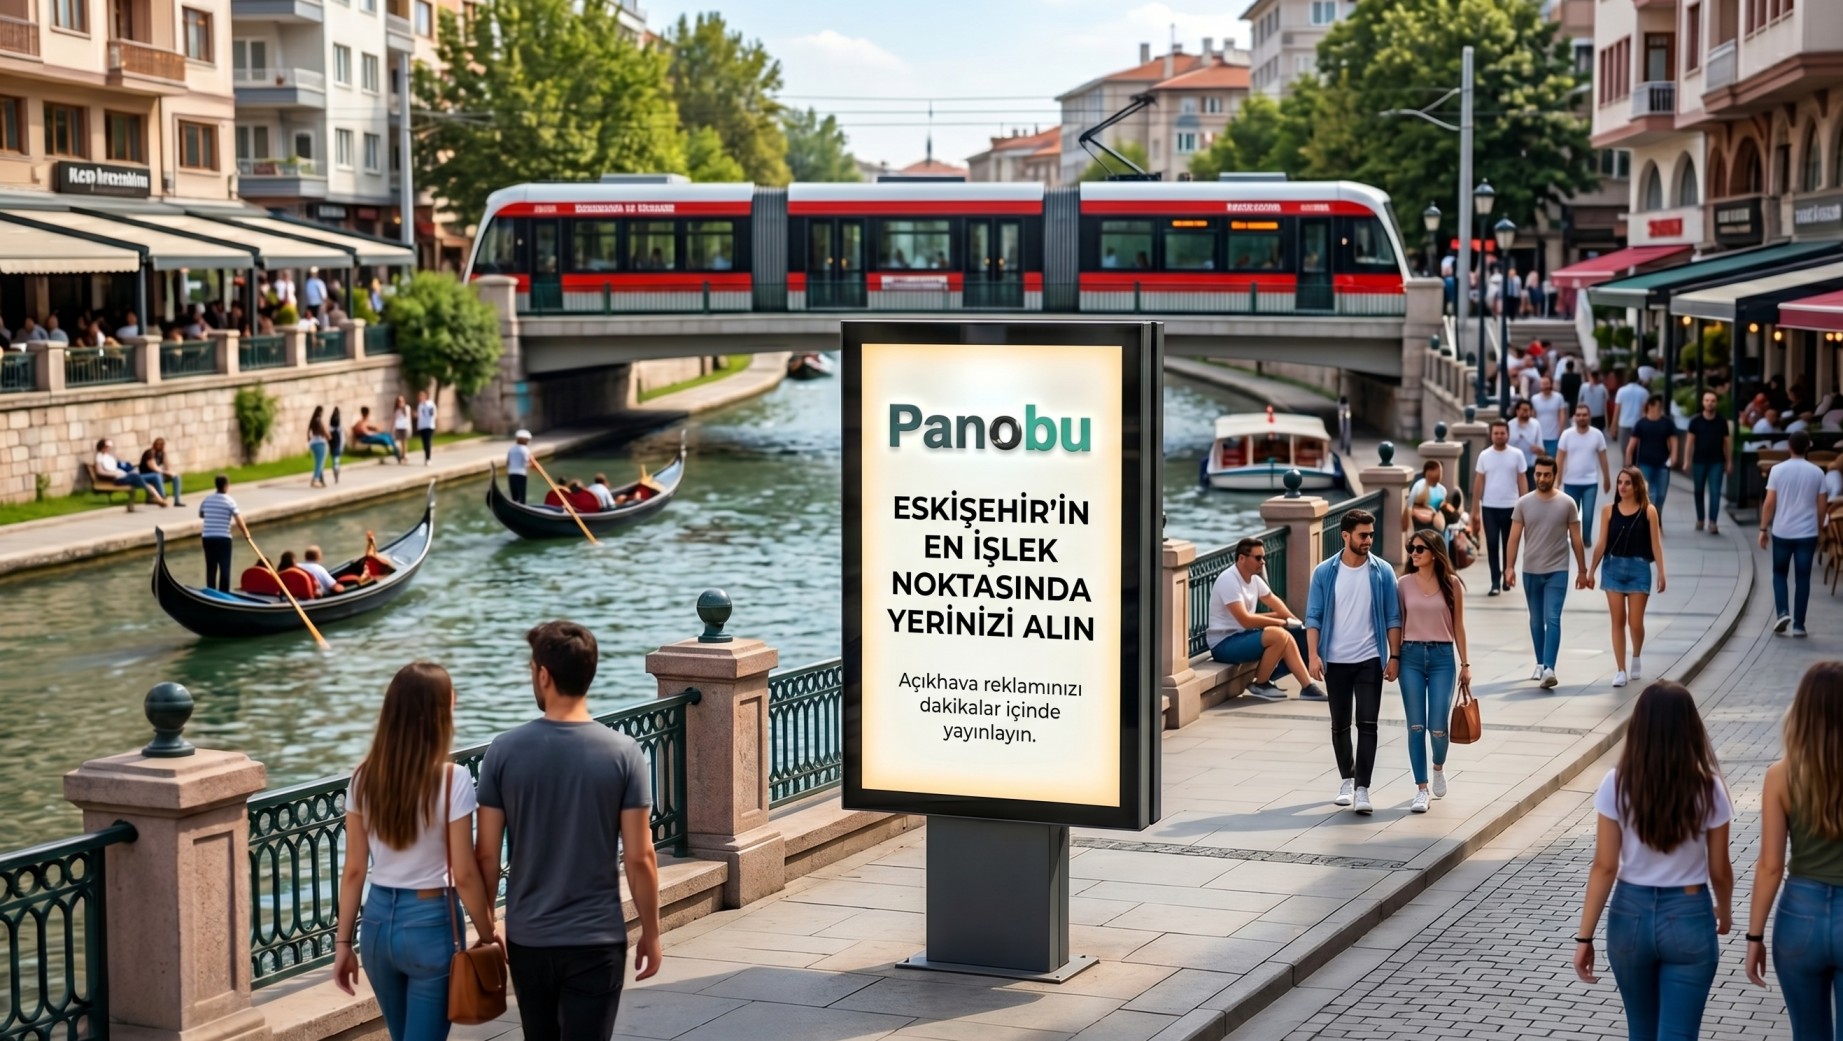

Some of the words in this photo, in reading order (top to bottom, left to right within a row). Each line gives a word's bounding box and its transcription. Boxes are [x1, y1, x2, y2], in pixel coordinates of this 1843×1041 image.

[889, 403, 1091, 453] Panobu
[894, 489, 1089, 528] ESKİŞEHİR’İN
[924, 534, 963, 560] EN
[974, 528, 1058, 568] İŞLEK
[892, 570, 1092, 603] NOKTASINDA
[886, 603, 1014, 638] YERİNİZİ
[1022, 614, 1094, 642] ALIN
[898, 672, 978, 693] Açıkhava
[984, 676, 1082, 697] reklamınızı
[919, 696, 1002, 717] dakikalar
[1006, 700, 1061, 722] içinde
[942, 723, 1036, 745] yayınlayın.
